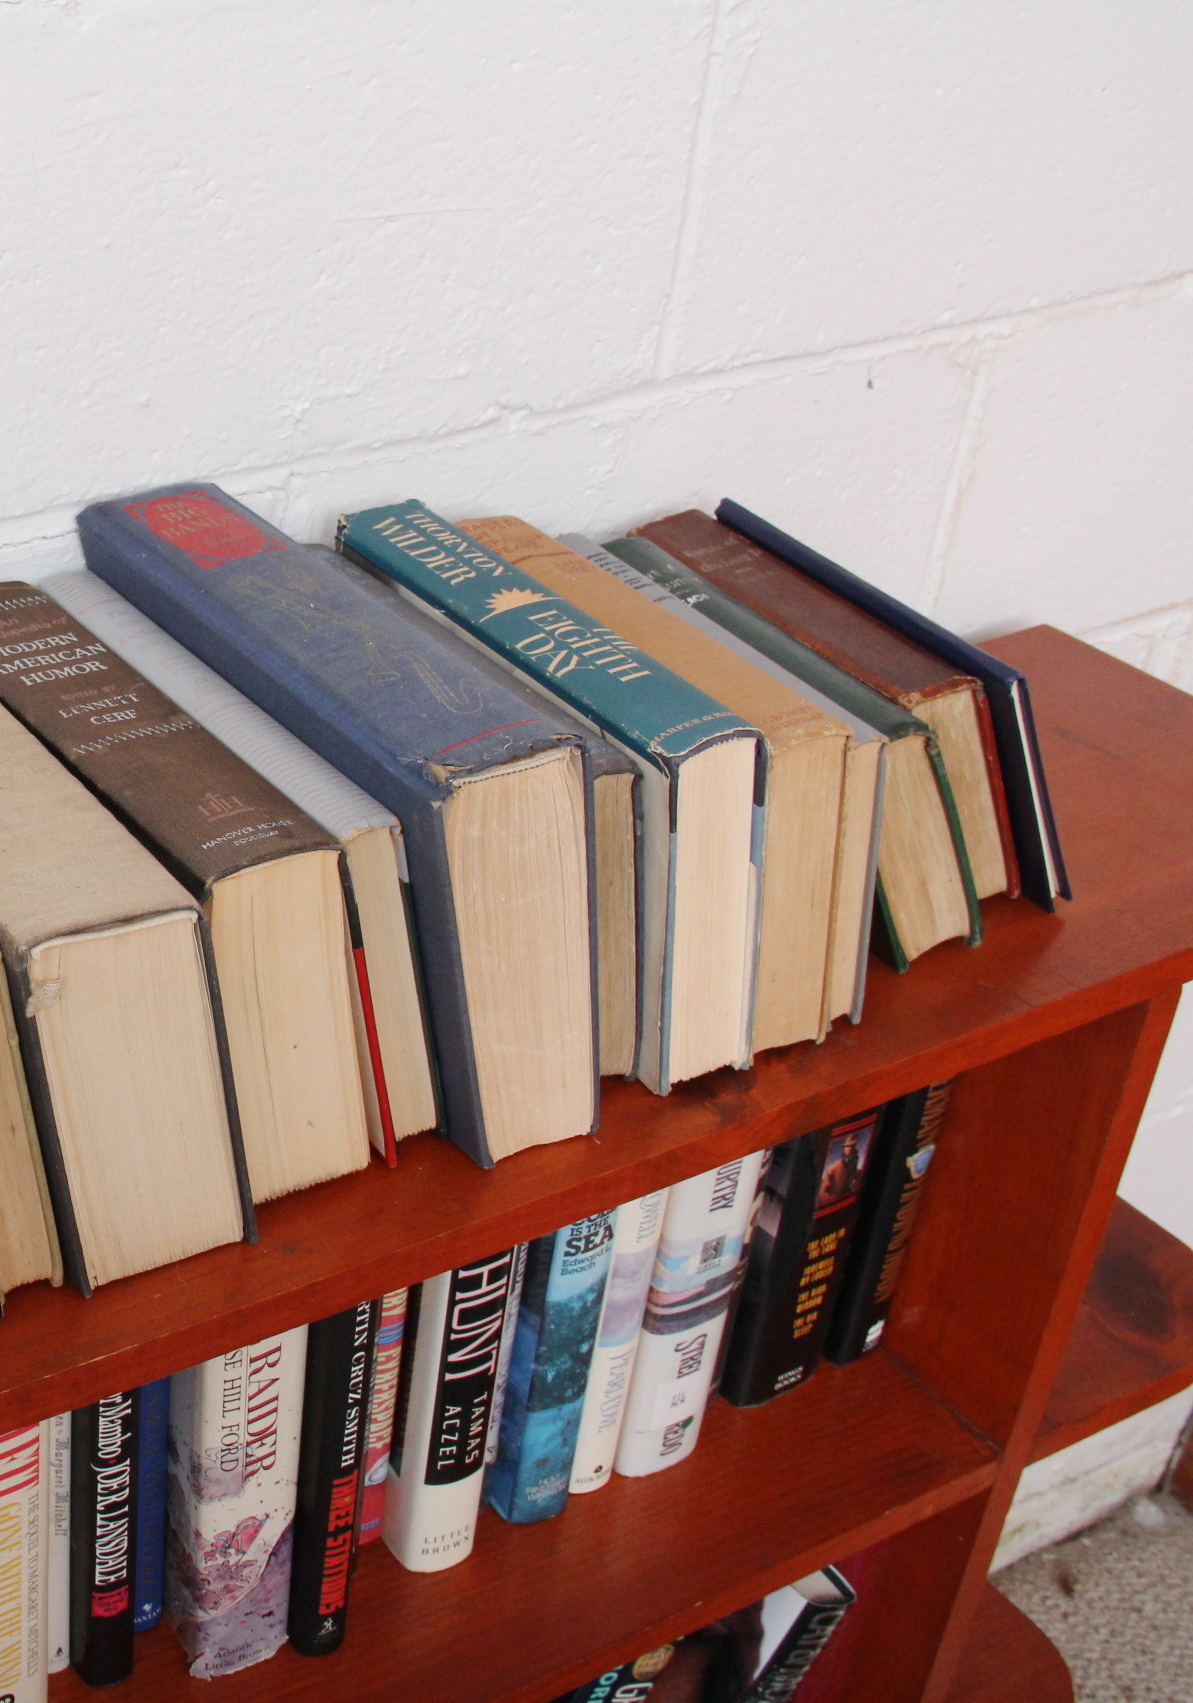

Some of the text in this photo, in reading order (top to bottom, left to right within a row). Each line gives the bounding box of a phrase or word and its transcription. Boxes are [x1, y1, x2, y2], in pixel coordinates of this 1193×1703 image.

[372, 516, 477, 585] WILDER
[404, 511, 513, 577] THORNTON
[513, 632, 597, 678] DAY
[527, 609, 652, 682] EIGHTH
[19, 660, 108, 687] HUMOR
[201, 825, 256, 850] HANOVER
[563, 1224, 614, 1257] SEA
[569, 1228, 583, 1237] IS
[585, 1216, 610, 1234] THE
[560, 1262, 596, 1277] Beach
[562, 1249, 604, 1269] Edward
[443, 1252, 511, 1382] HUNT
[221, 1378, 243, 1419] HILL
[345, 1350, 367, 1402] CRUZ
[368, 1346, 402, 1448] CYBERSPACE
[98, 1395, 133, 1460] Mambo
[243, 1341, 283, 1482] RAIDER
[340, 1405, 361, 1468] SMITH
[463, 1390, 488, 1466] TAMAS
[219, 1422, 241, 1473] FORD
[437, 1405, 454, 1471] ACZEL
[89, 1458, 132, 1499] JOE
[328, 1470, 359, 1532] THREE
[54, 1491, 69, 1538] Mitchell
[424, 1524, 470, 1544] LITTLE
[94, 1520, 129, 1587] LANSDALE
[421, 1534, 470, 1555] BROWN
[318, 1532, 352, 1616] STATIONS
